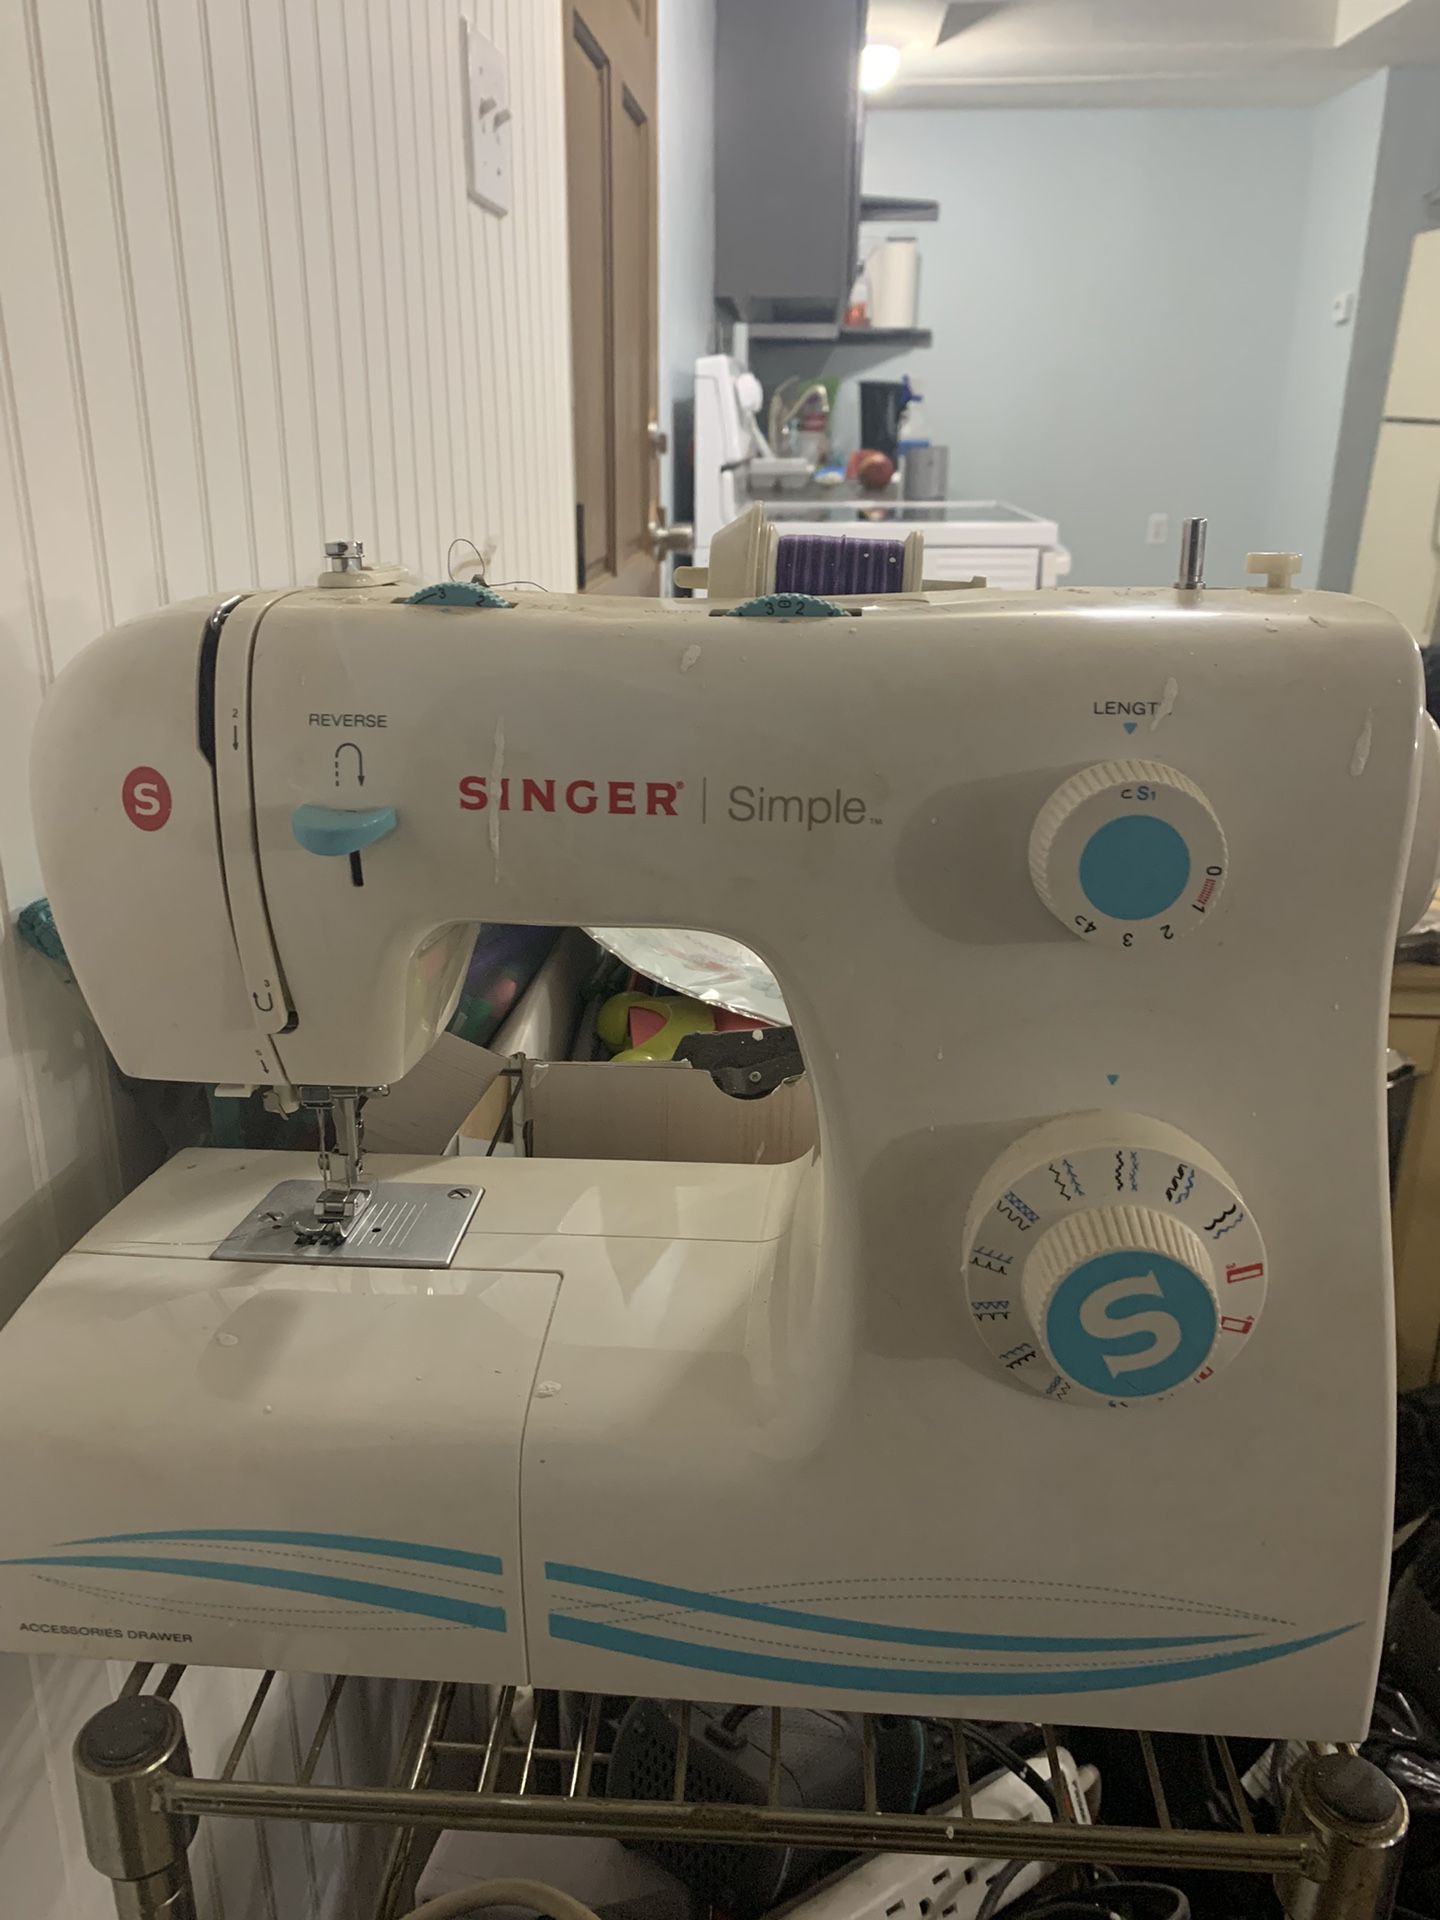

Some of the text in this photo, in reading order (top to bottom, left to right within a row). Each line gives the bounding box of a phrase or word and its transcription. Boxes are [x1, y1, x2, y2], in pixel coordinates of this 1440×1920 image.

[438, 587, 447, 599] 3
[764, 602, 775, 616] 3
[795, 602, 805, 616] 2
[232, 708, 239, 718] 2
[1093, 701, 1172, 716] LENGT
[308, 713, 387, 728] REVERSE
[133, 782, 160, 816] S
[1206, 865, 1223, 876] 0
[1084, 921, 1097, 934] 4
[1160, 924, 1174, 940] 2
[1122, 932, 1134, 947] 3
[1079, 1269, 1182, 1379] S
[19, 1622, 193, 1643] ACCESSORIES DRAWER
